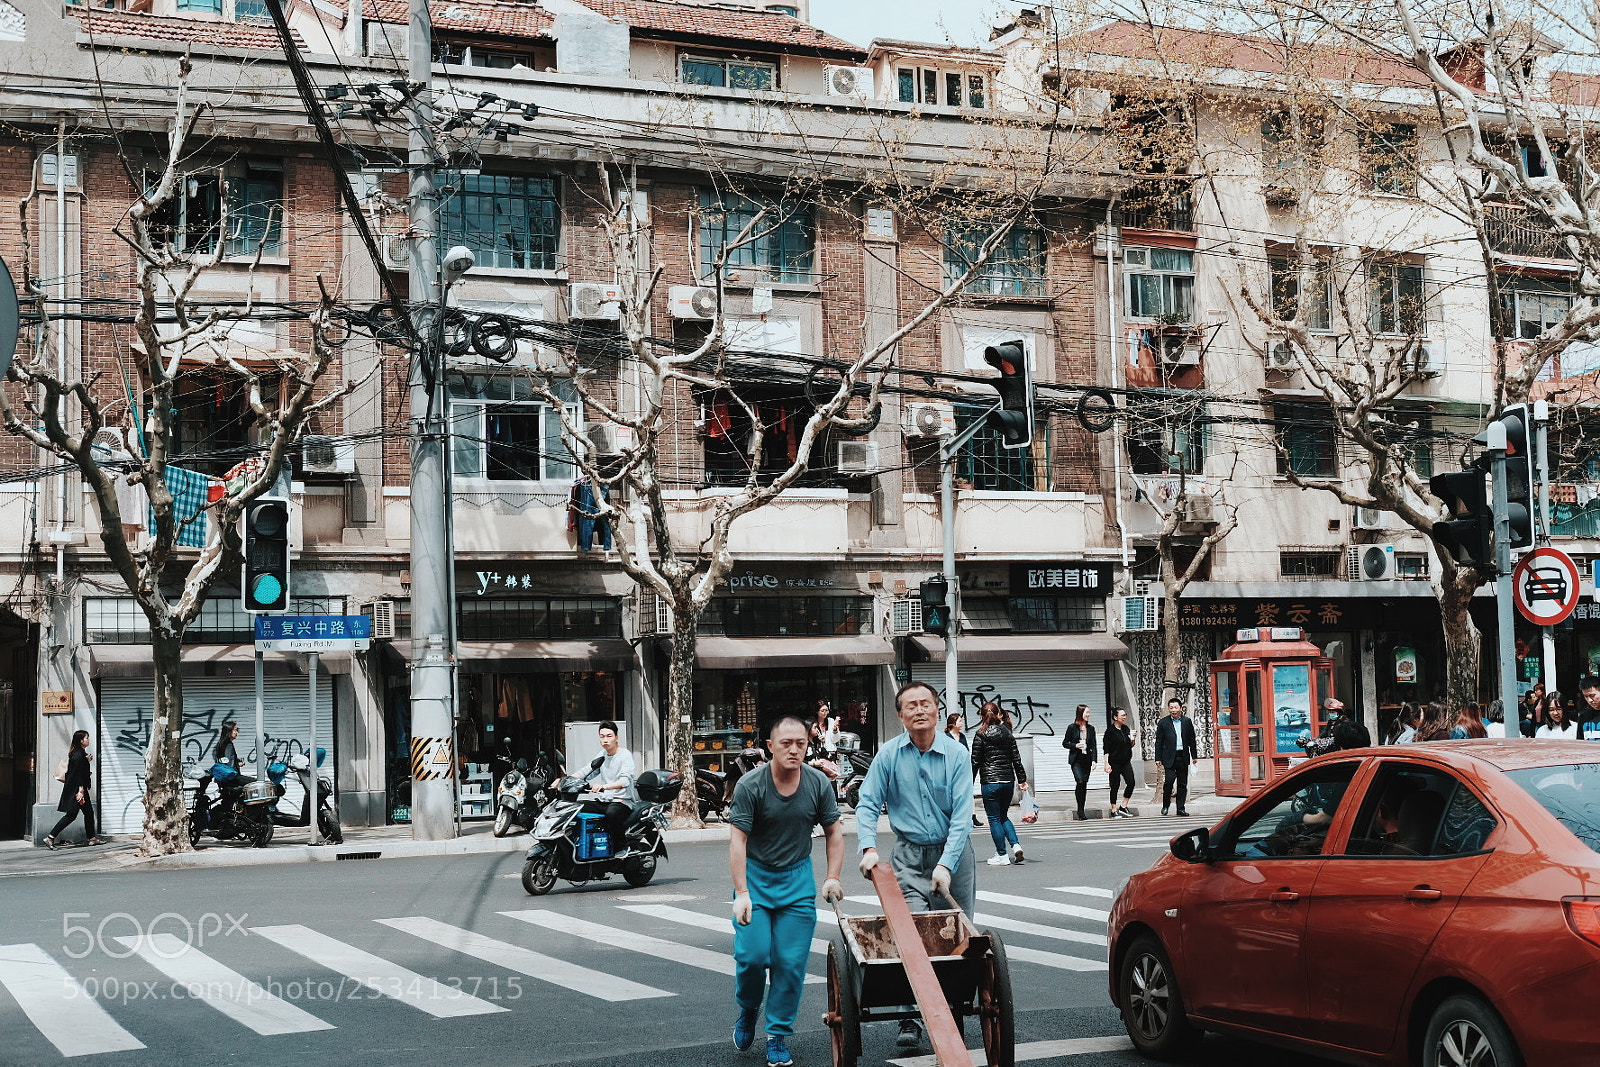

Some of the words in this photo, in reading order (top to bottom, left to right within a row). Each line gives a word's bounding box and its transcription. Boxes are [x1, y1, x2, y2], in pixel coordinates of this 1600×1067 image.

[504, 573, 533, 589] 韩装
[1028, 569, 1099, 589] 欧美首饰
[1180, 617, 1238, 626] 13801924345
[1254, 602, 1343, 626] 紫云斋
[281, 620, 346, 637] 复兴中路
[262, 641, 272, 649] W
[354, 640, 361, 648] E
